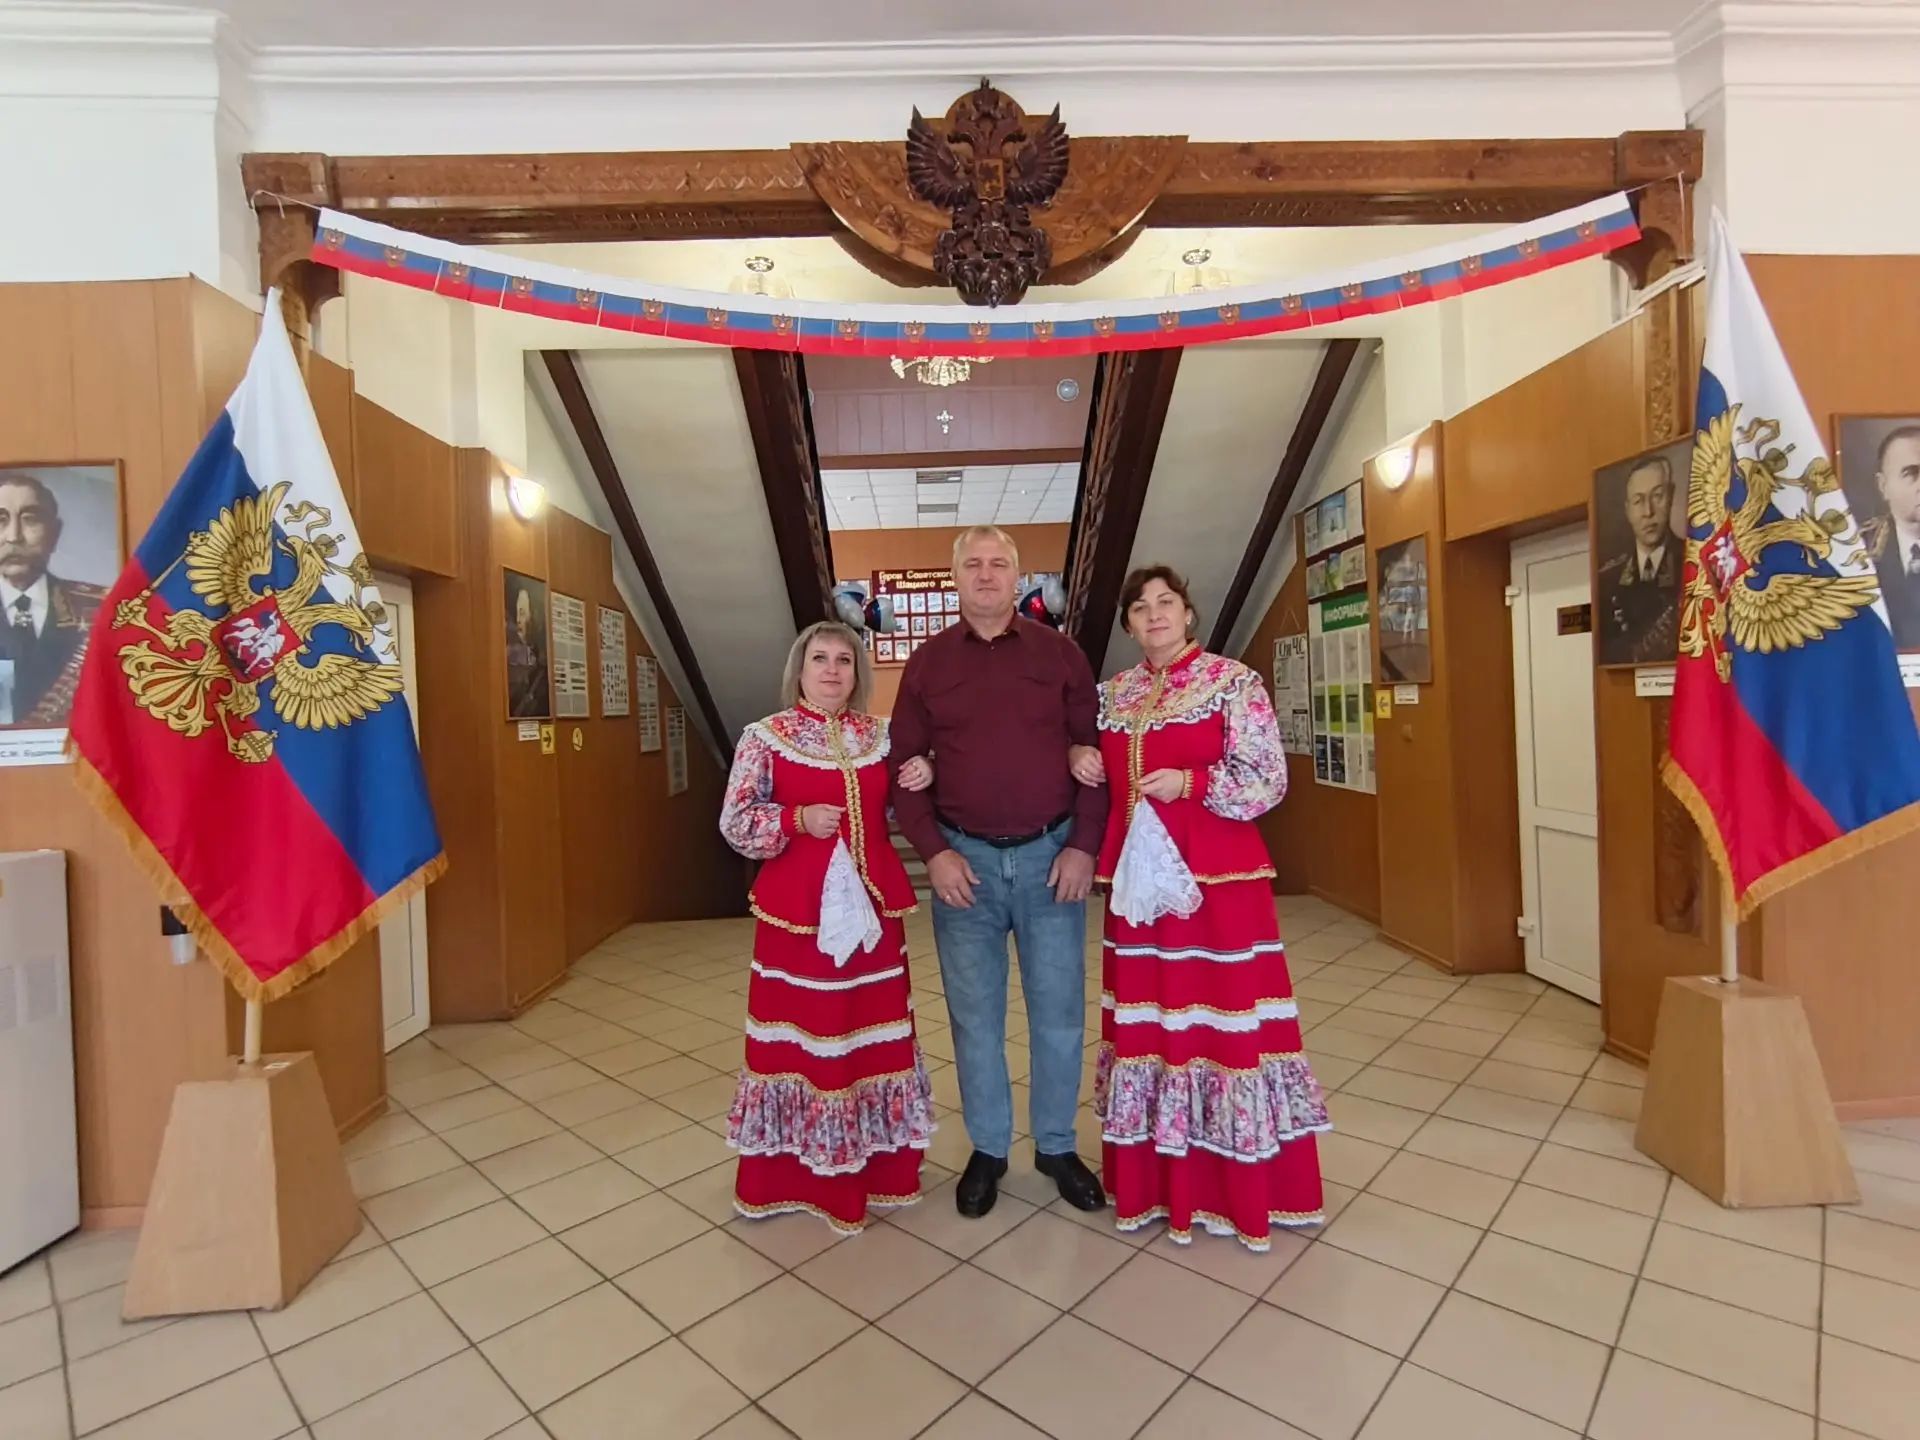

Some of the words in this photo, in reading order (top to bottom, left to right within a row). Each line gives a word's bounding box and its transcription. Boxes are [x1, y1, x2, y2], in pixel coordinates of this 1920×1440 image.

[879, 571, 903, 581] Герои
[896, 580, 936, 589] Шацкого
[1324, 600, 1369, 623] ИНФОРМАЦИ
